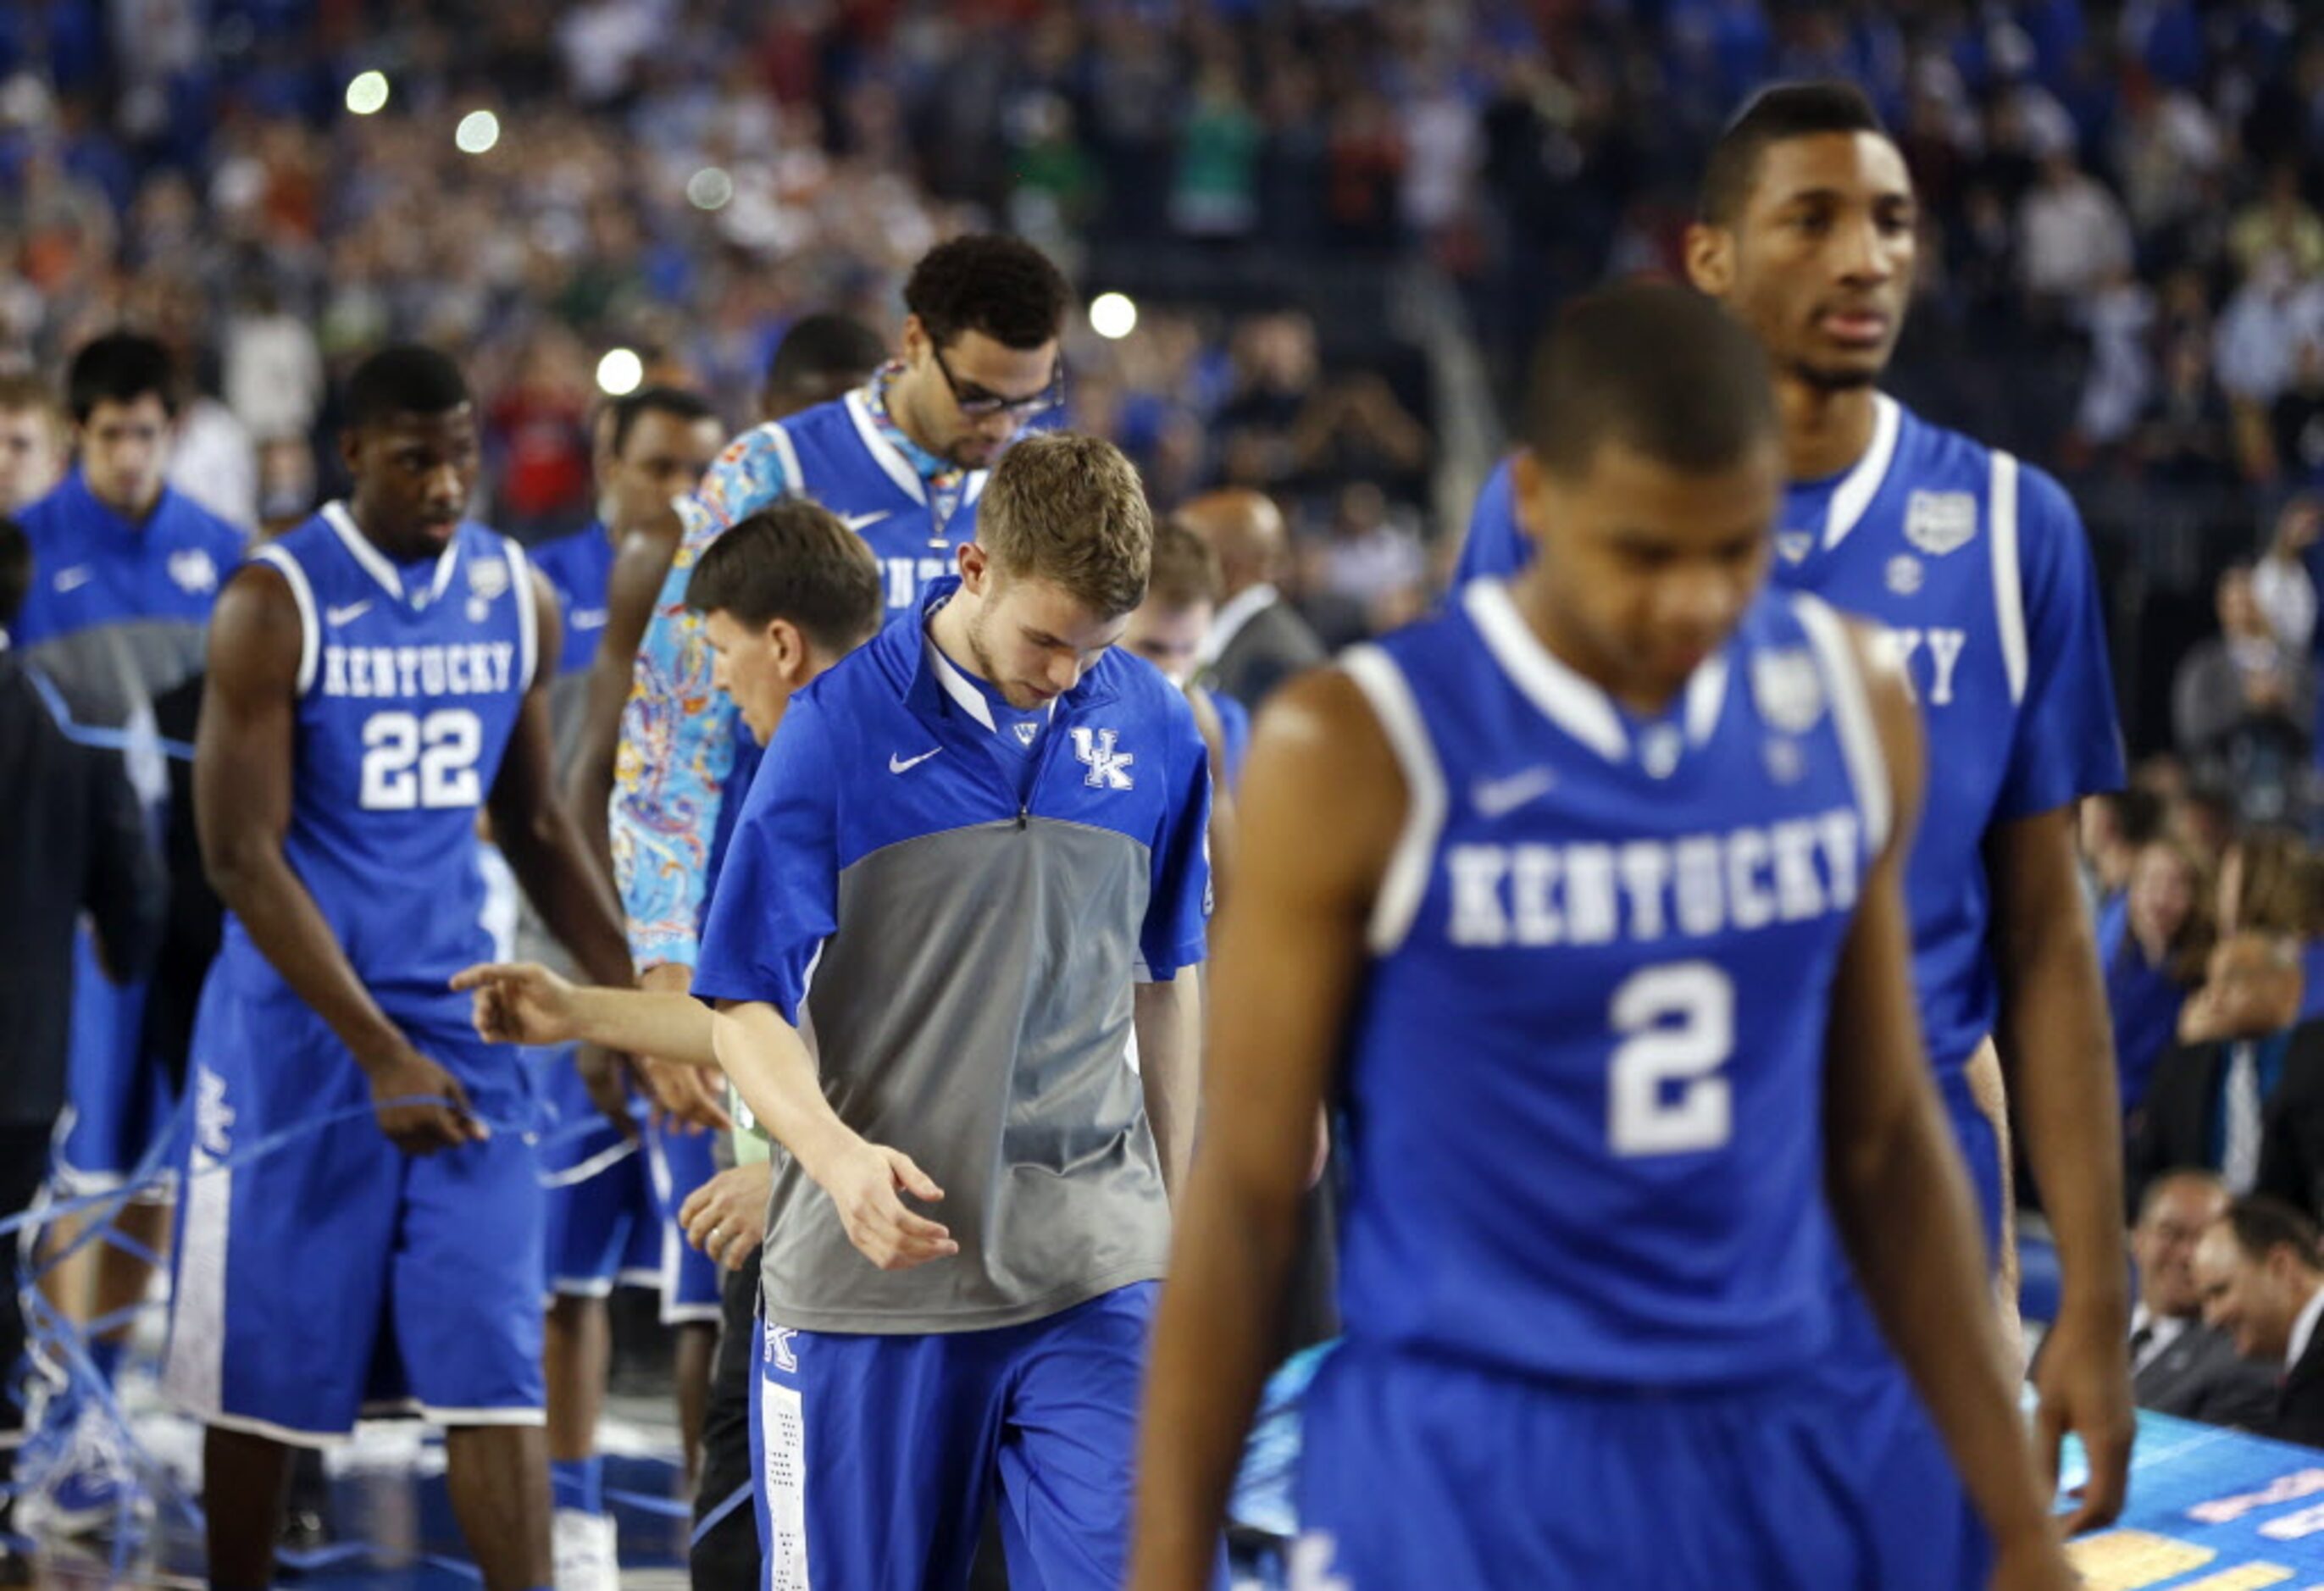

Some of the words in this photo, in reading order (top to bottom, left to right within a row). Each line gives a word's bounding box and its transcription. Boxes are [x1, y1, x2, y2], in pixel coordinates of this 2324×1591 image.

[324, 641, 513, 697] KENTUCKY
[360, 708, 482, 810] 22
[1071, 726, 1134, 790] UK
[1450, 808, 1860, 945] KENTUCKY
[1610, 960, 1733, 1156] 2
